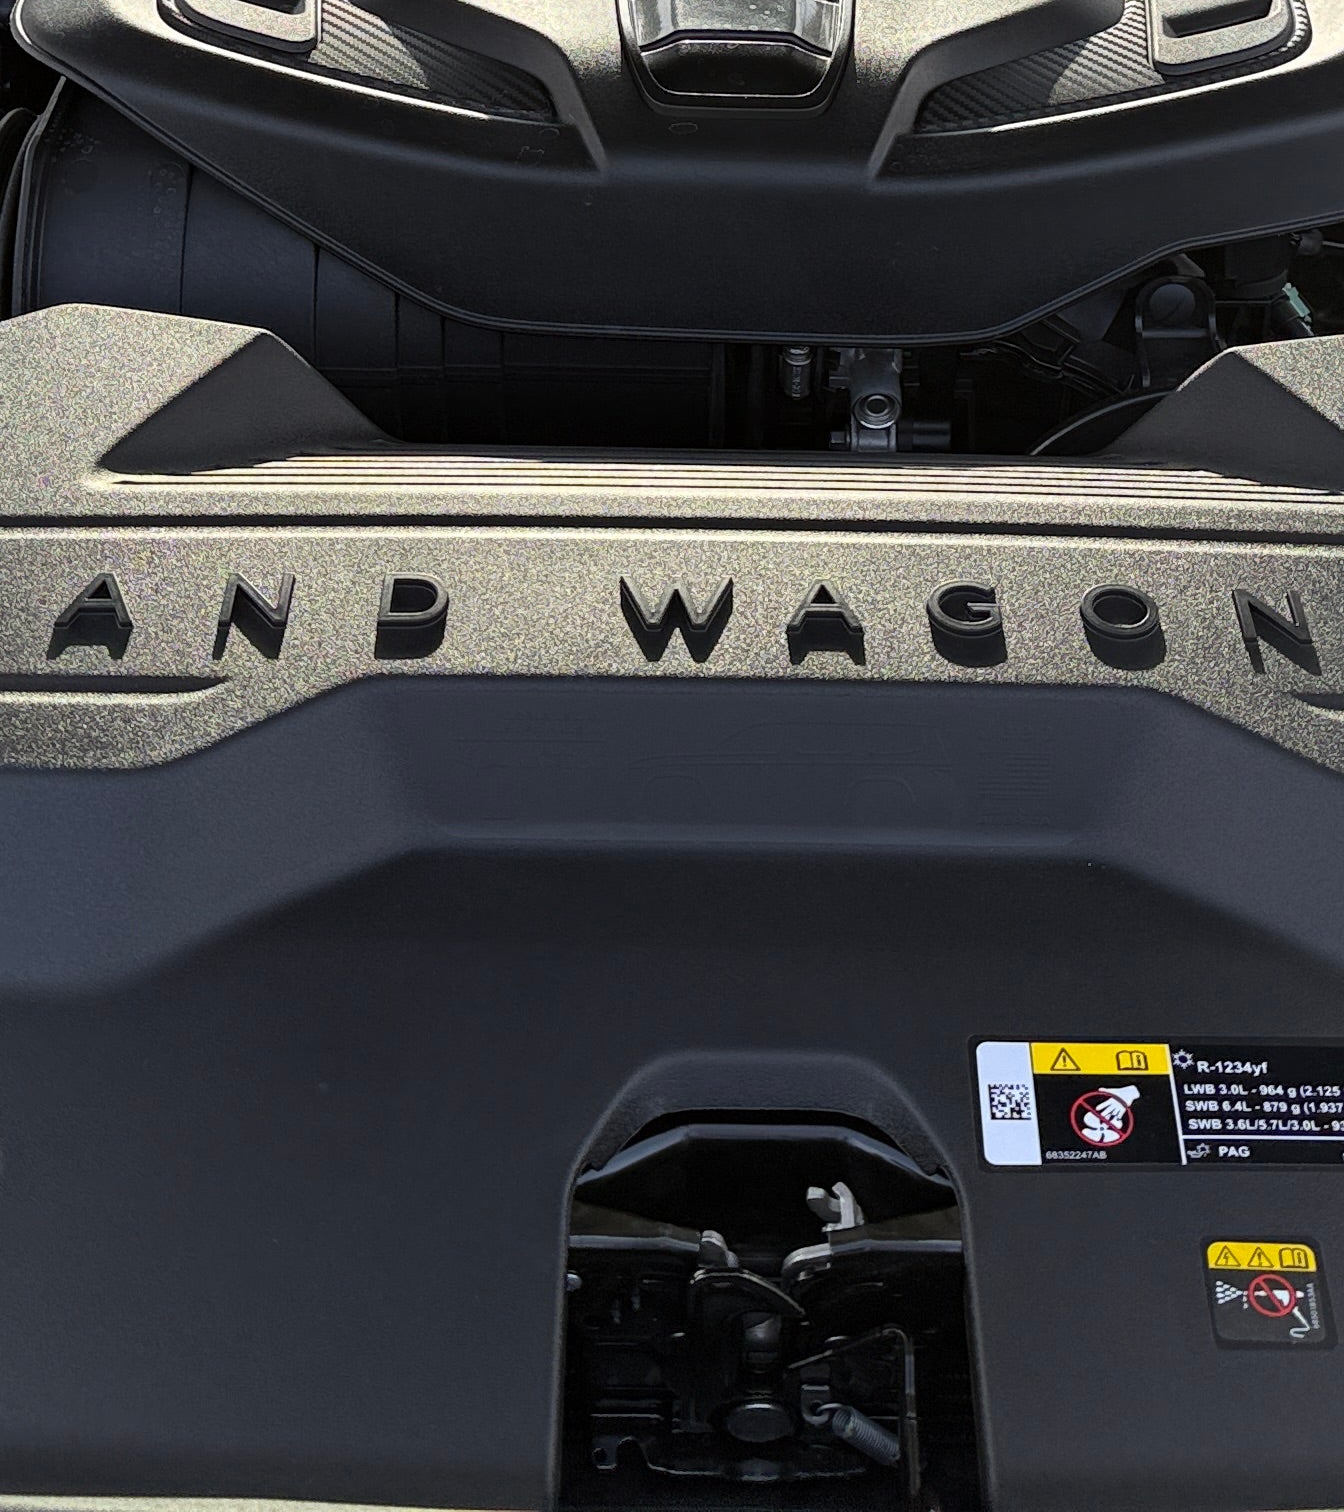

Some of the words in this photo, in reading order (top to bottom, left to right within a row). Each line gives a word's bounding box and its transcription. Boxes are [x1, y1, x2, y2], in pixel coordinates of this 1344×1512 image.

[1197, 1061, 1268, 1076] R-1234yf
[1183, 1084, 1216, 1095] LWB
[1219, 1084, 1248, 1095] 3.0L
[1259, 1085, 1284, 1096] 964
[1287, 1088, 1297, 1098] g
[1300, 1085, 1340, 1098] (2.125
[1185, 1100, 1219, 1112] SWB
[1222, 1101, 1252, 1112] 6.4L
[1263, 1102, 1288, 1113] 879
[1291, 1104, 1301, 1115] g
[1303, 1102, 1343, 1115] (1.937
[1188, 1118, 1222, 1130] SWB
[1225, 1119, 1321, 1131] 3.6L/5.7L/3.0L
[1218, 1146, 1250, 1158] PAG
